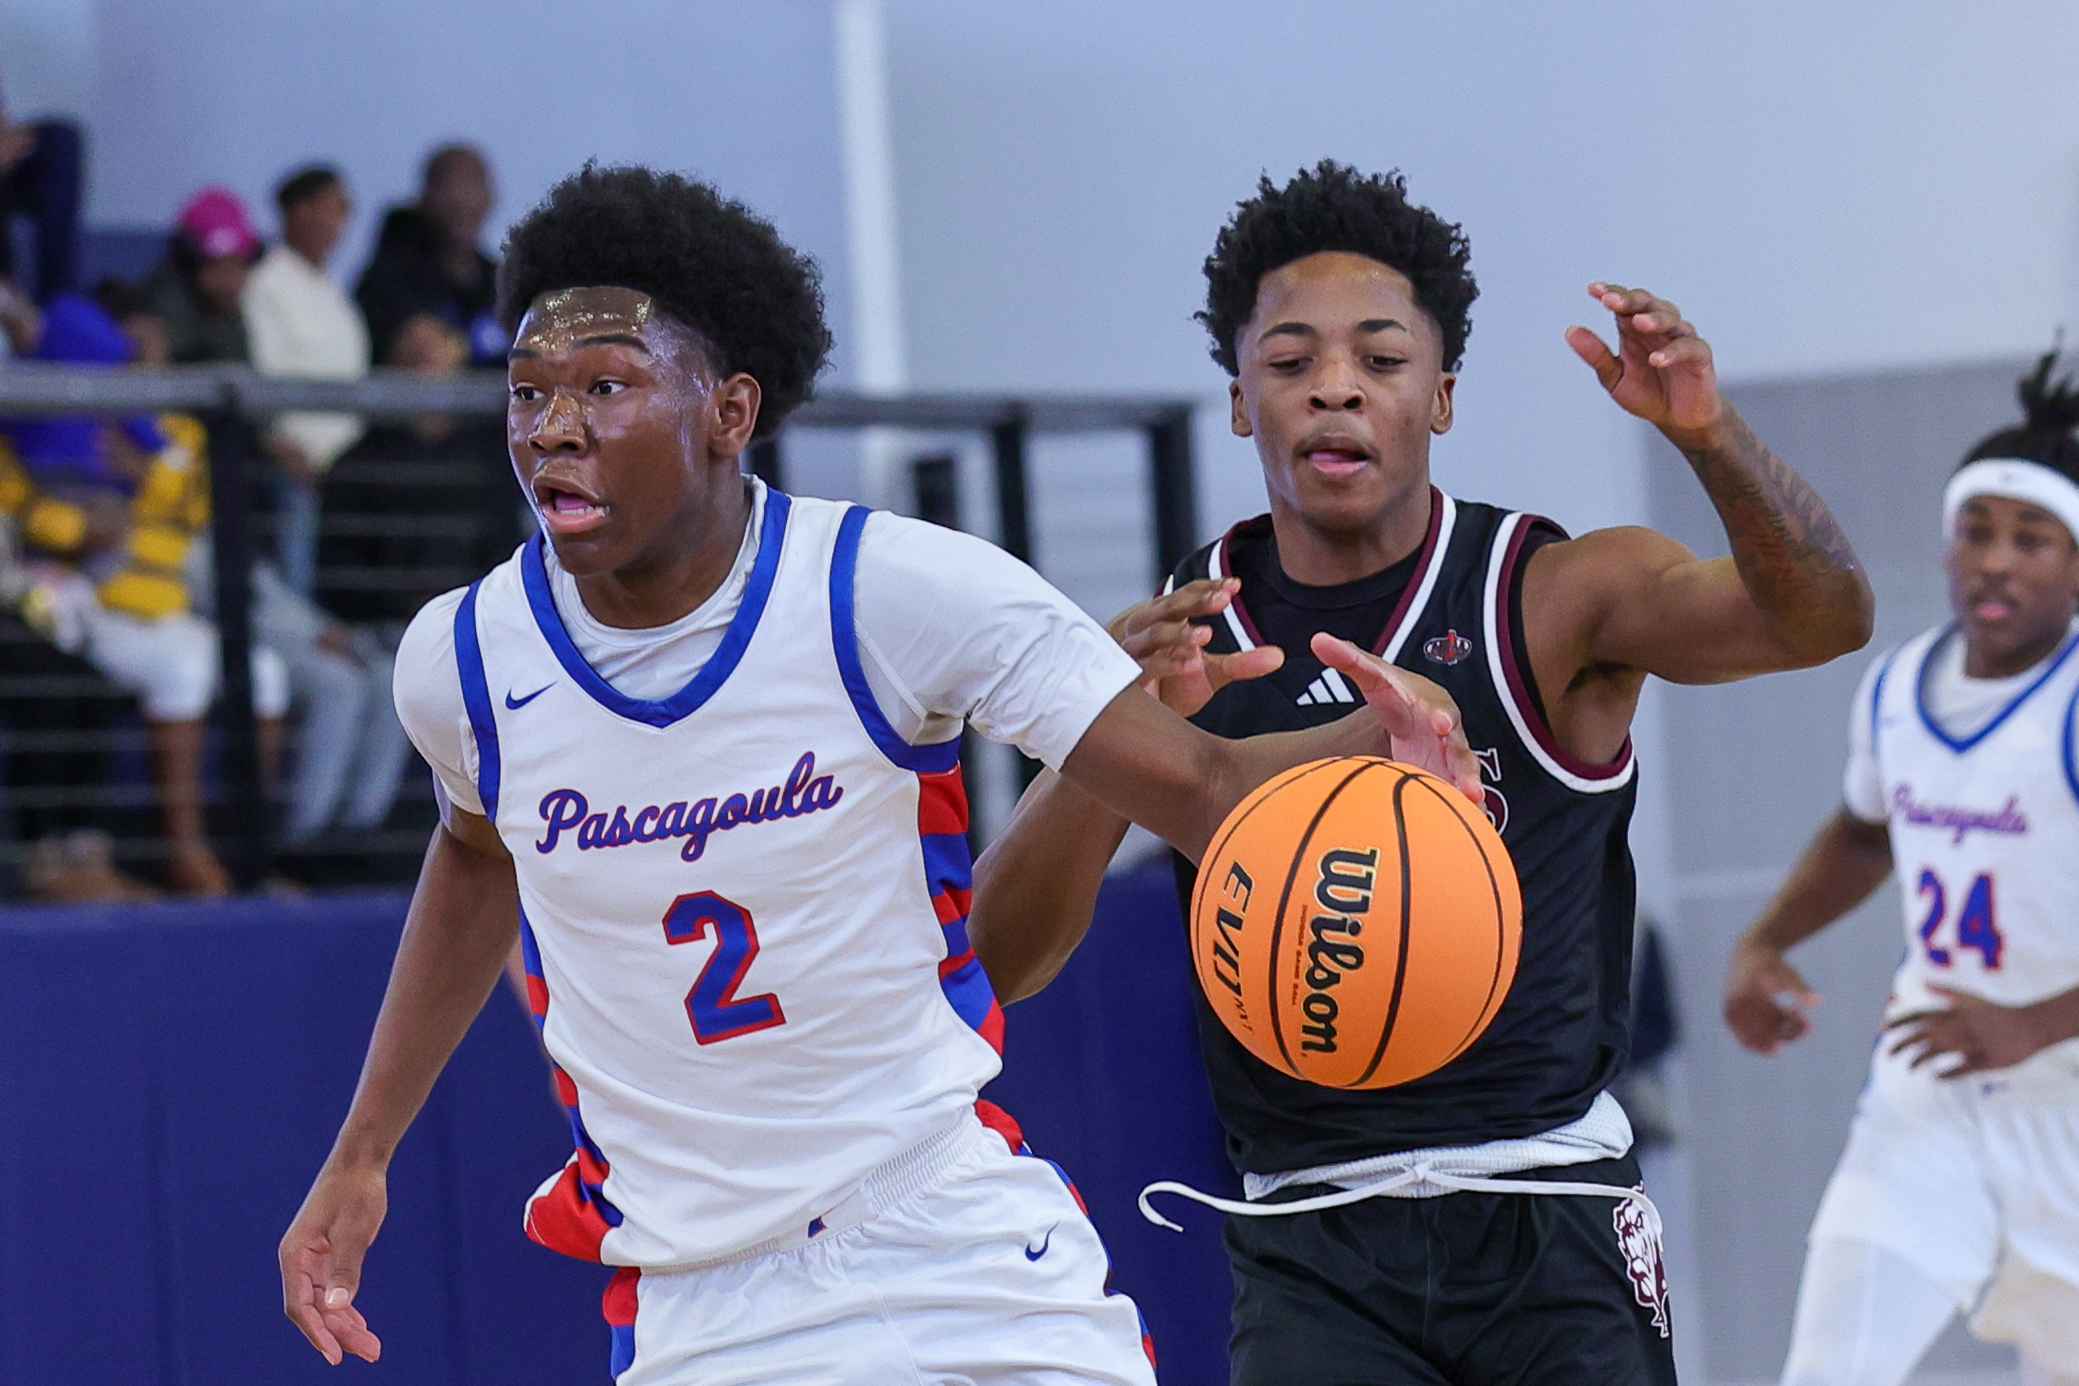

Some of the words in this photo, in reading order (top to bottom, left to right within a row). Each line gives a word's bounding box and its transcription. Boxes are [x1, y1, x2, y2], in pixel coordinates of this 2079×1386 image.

[535, 751, 844, 862] Pascagoula
[662, 889, 787, 1046] 2
[1213, 860, 1255, 997] EVO
[1301, 846, 1381, 1053] Wilson
[1917, 867, 2005, 972] 24
